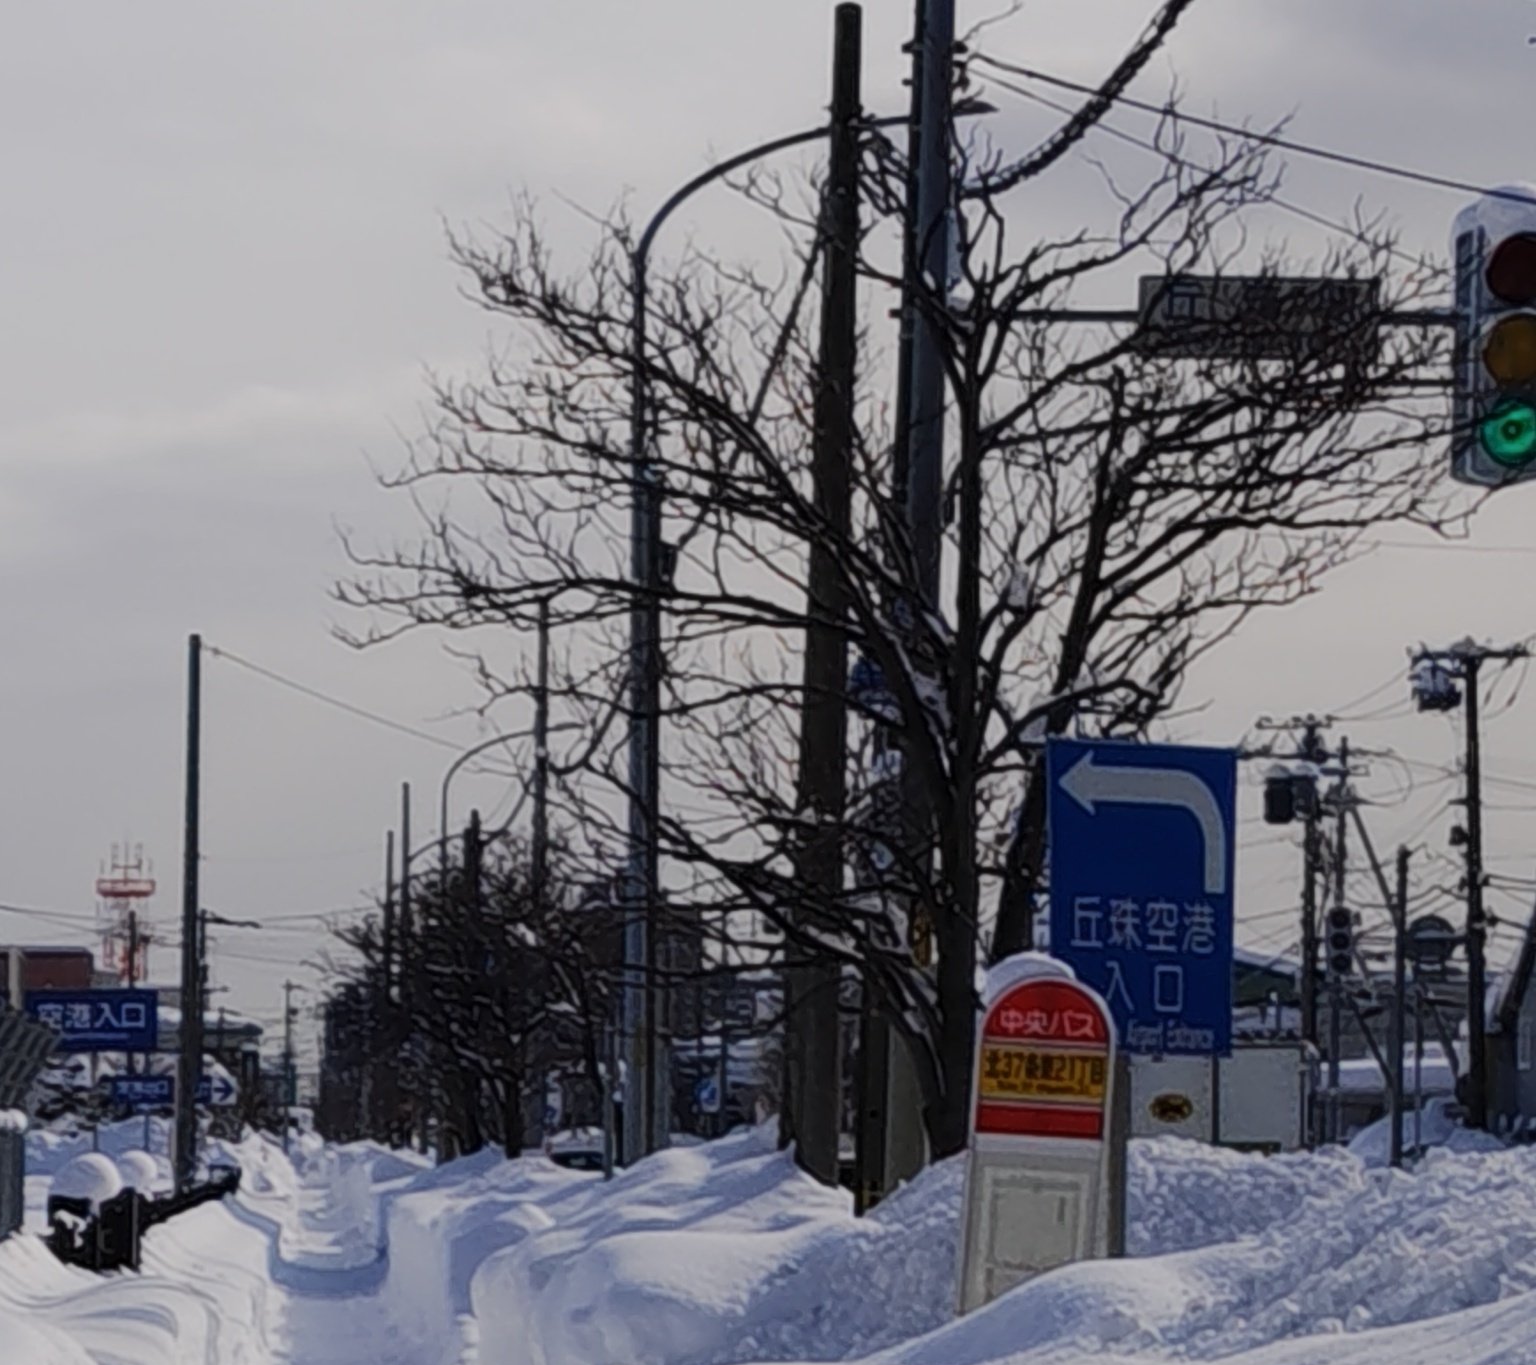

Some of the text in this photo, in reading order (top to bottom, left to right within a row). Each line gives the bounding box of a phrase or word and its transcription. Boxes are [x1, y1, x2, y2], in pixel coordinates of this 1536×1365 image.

[1070, 895, 1216, 954] 丘珠空港
[1105, 960, 1184, 1014] 入口
[37, 1002, 145, 1030] 空港入口
[999, 1009, 1096, 1039] 中央バス
